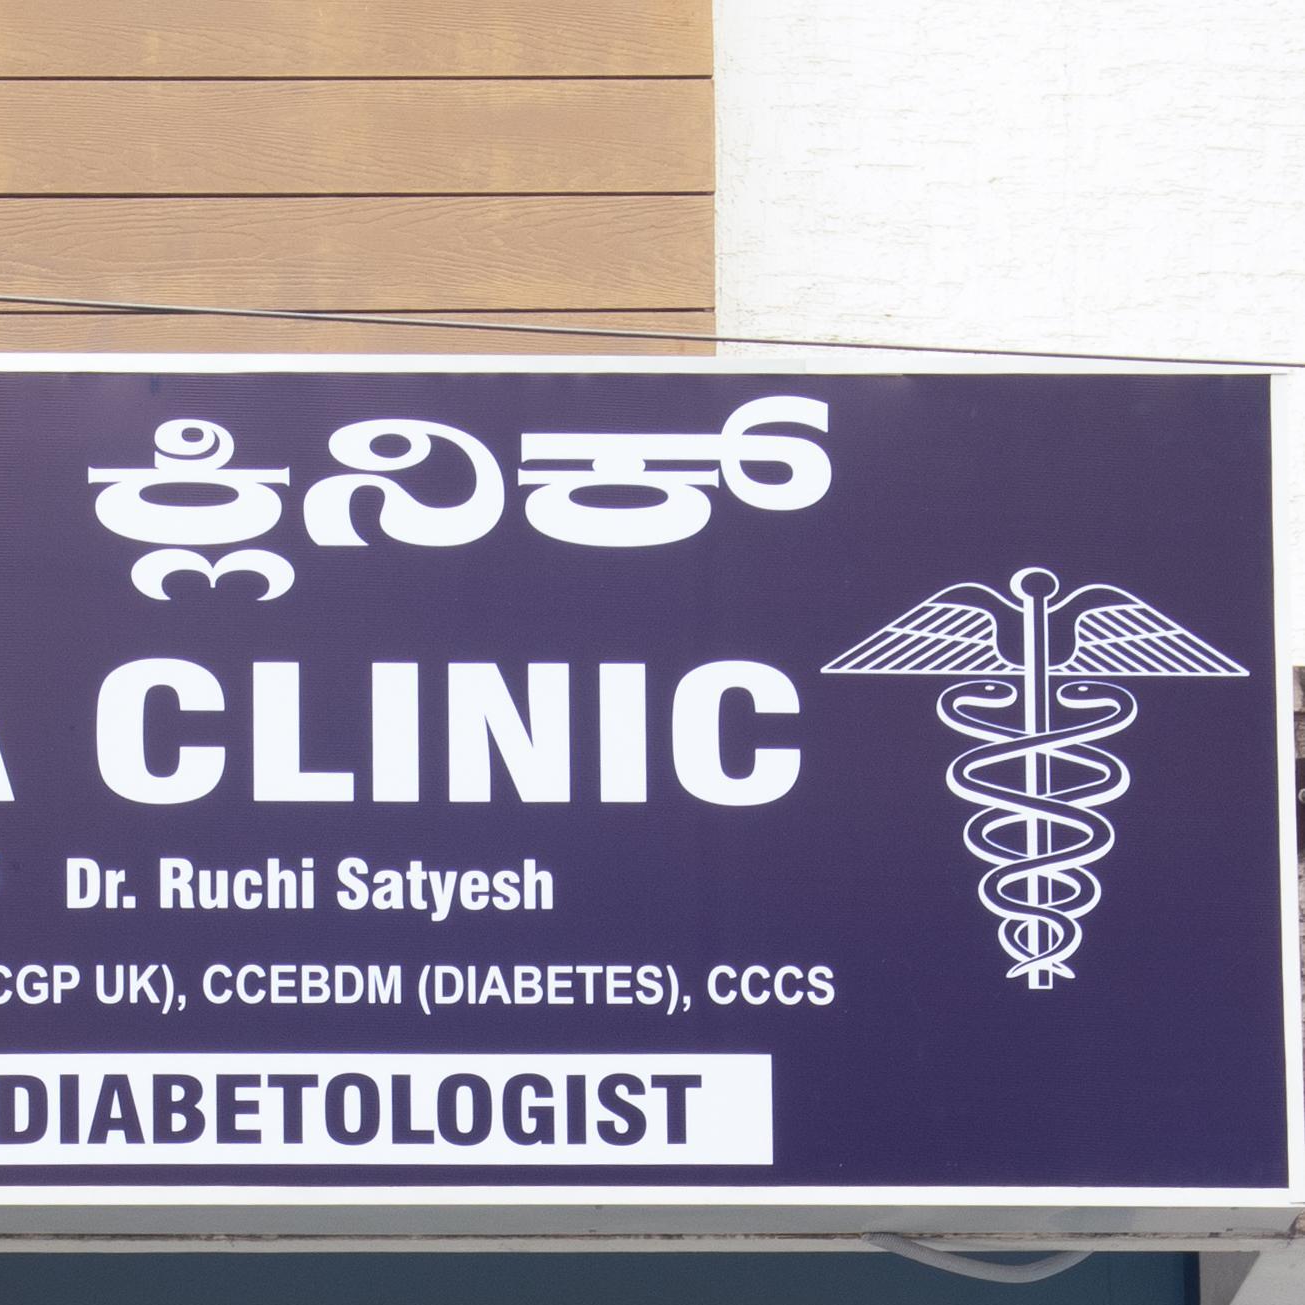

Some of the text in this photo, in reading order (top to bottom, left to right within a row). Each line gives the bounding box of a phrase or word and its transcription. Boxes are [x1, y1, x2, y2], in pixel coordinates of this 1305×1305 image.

[88, 396, 831, 600] ಕ್ಲಿನಿಕ್
[97, 658, 800, 806] CLINIC
[67, 857, 553, 921] Dr. Ruchi Satyesh
[96, 964, 186, 1014] UK),
[203, 965, 401, 1004] CCEBDM
[419, 965, 690, 1015] (DIABETES),
[708, 965, 834, 1005] CCCS
